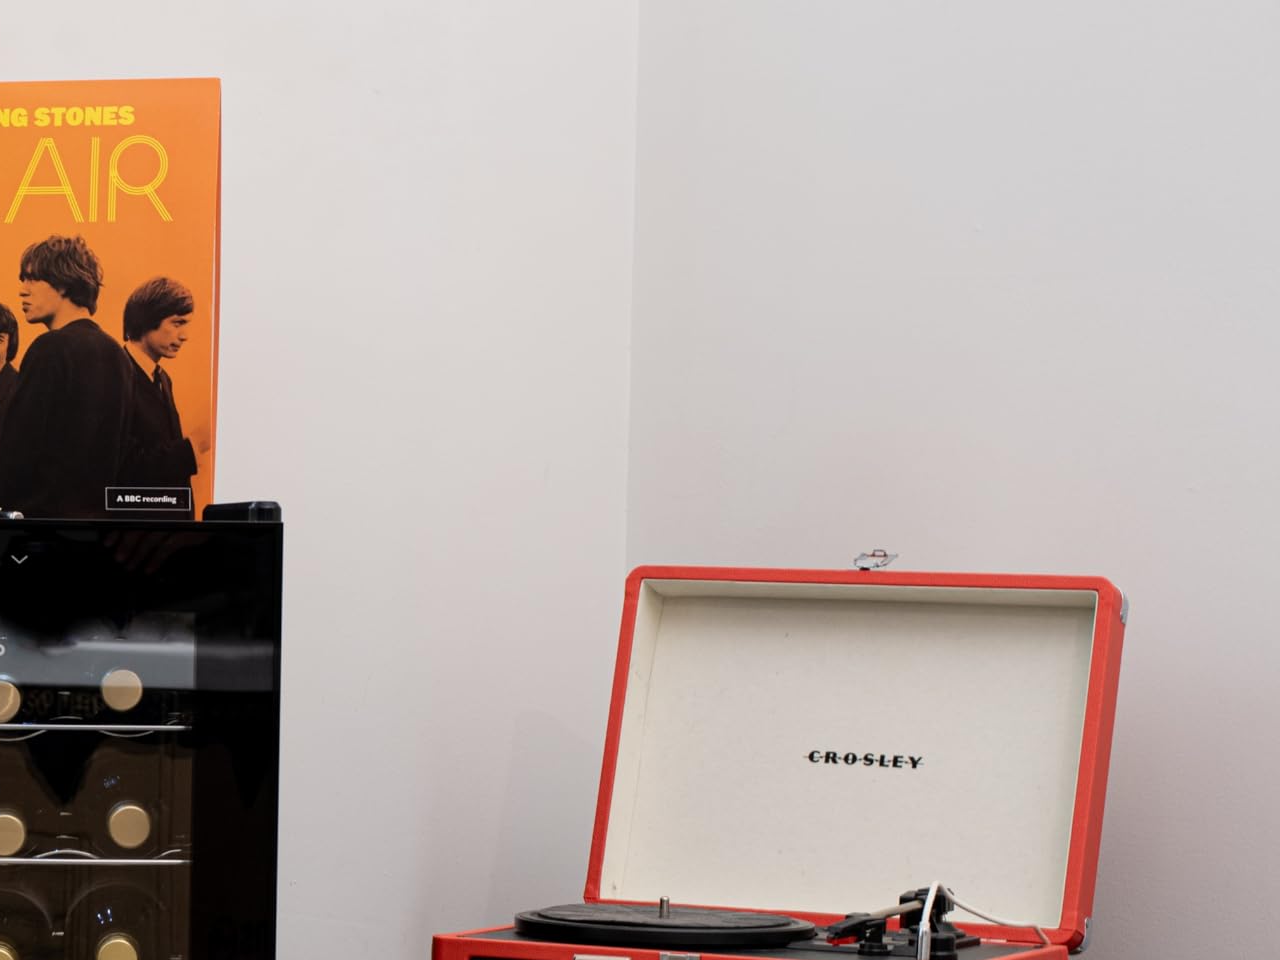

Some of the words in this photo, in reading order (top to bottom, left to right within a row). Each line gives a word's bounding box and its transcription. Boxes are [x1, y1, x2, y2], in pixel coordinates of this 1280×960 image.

[34, 105, 135, 127] STONES
[4, 134, 174, 224] AIR
[116, 495, 123, 503] A
[124, 495, 141, 503] BBC
[142, 496, 177, 505] recording
[807, 749, 924, 769] CROSLEY
